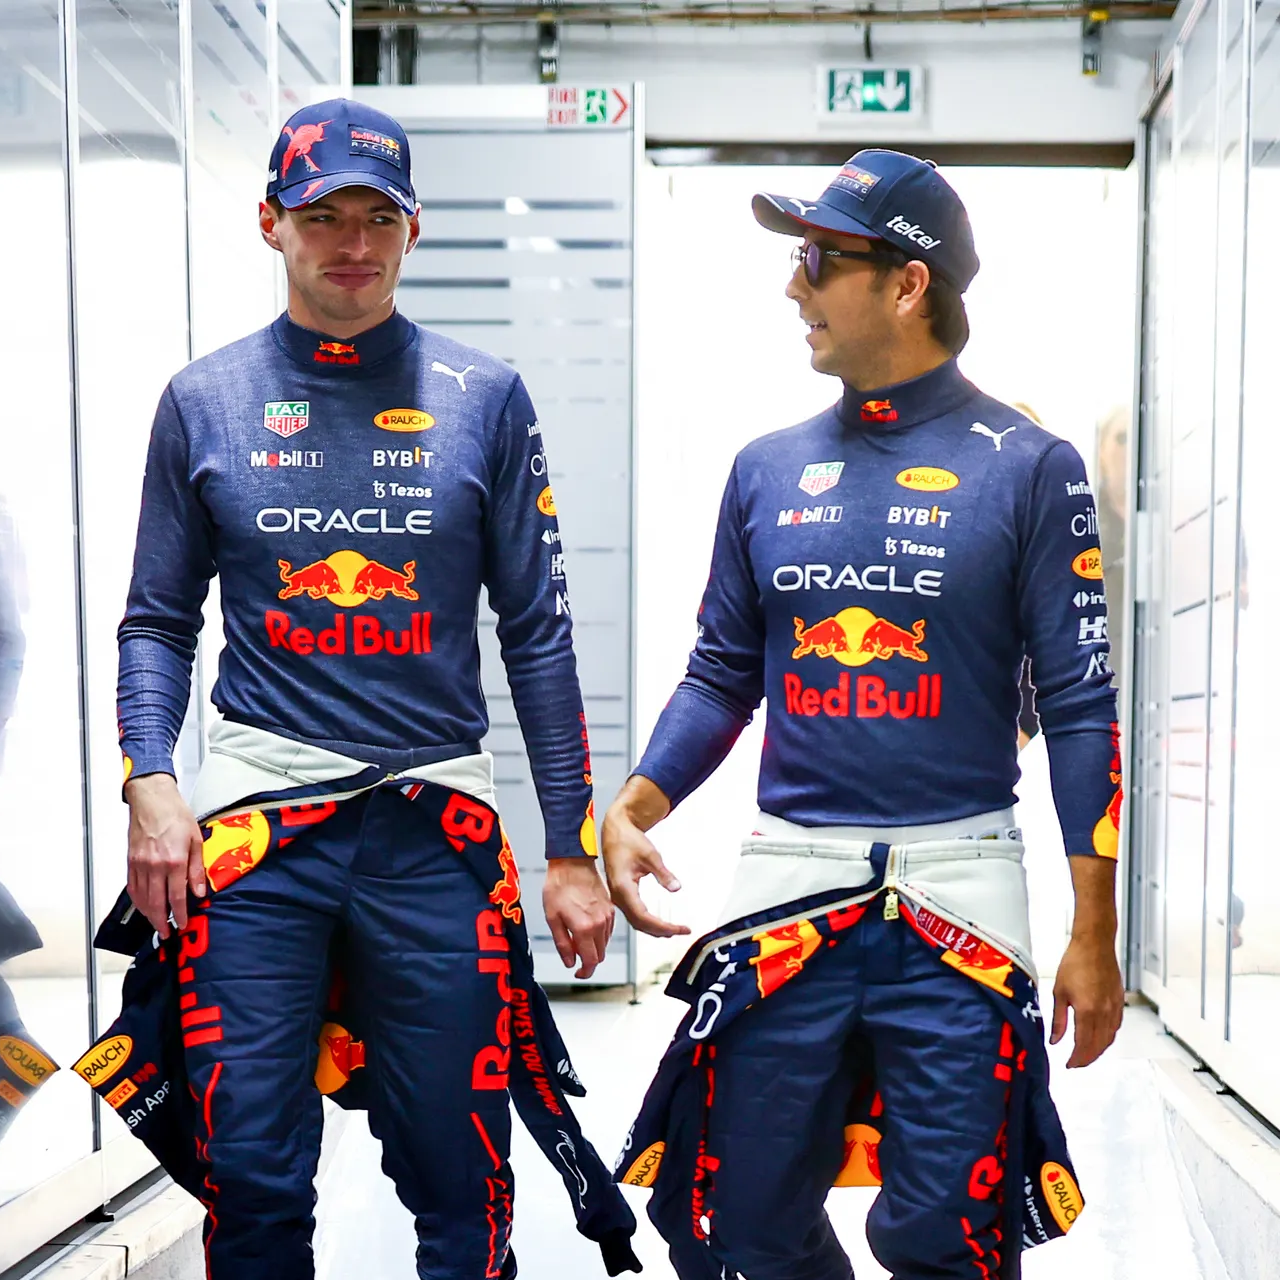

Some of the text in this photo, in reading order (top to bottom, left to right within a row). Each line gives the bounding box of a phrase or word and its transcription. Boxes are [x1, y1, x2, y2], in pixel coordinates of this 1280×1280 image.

[351, 141, 400, 160] RACING
[886, 214, 941, 250] telcel
[268, 404, 305, 416] TAG
[390, 415, 426, 425] RAUCH
[267, 417, 306, 435] HEUER
[250, 450, 302, 468] Mobil
[373, 446, 434, 469] BYBIT
[806, 464, 841, 477] TAG
[913, 473, 950, 485] RAUCH
[389, 482, 433, 498] Tezos
[256, 507, 433, 535] ORACLE
[777, 506, 824, 526] Mobil
[887, 505, 951, 529] BYBIT
[900, 540, 946, 558] Tezos
[773, 564, 944, 597] ORACLE
[265, 609, 432, 655] Red Bull
[784, 671, 943, 719] Red Bull
[510, 988, 545, 1073] GIVES YOU
[83, 1041, 126, 1080] RAUCH
[630, 1149, 663, 1187] RAUCH
[1052, 1181, 1078, 1224] RAUC
